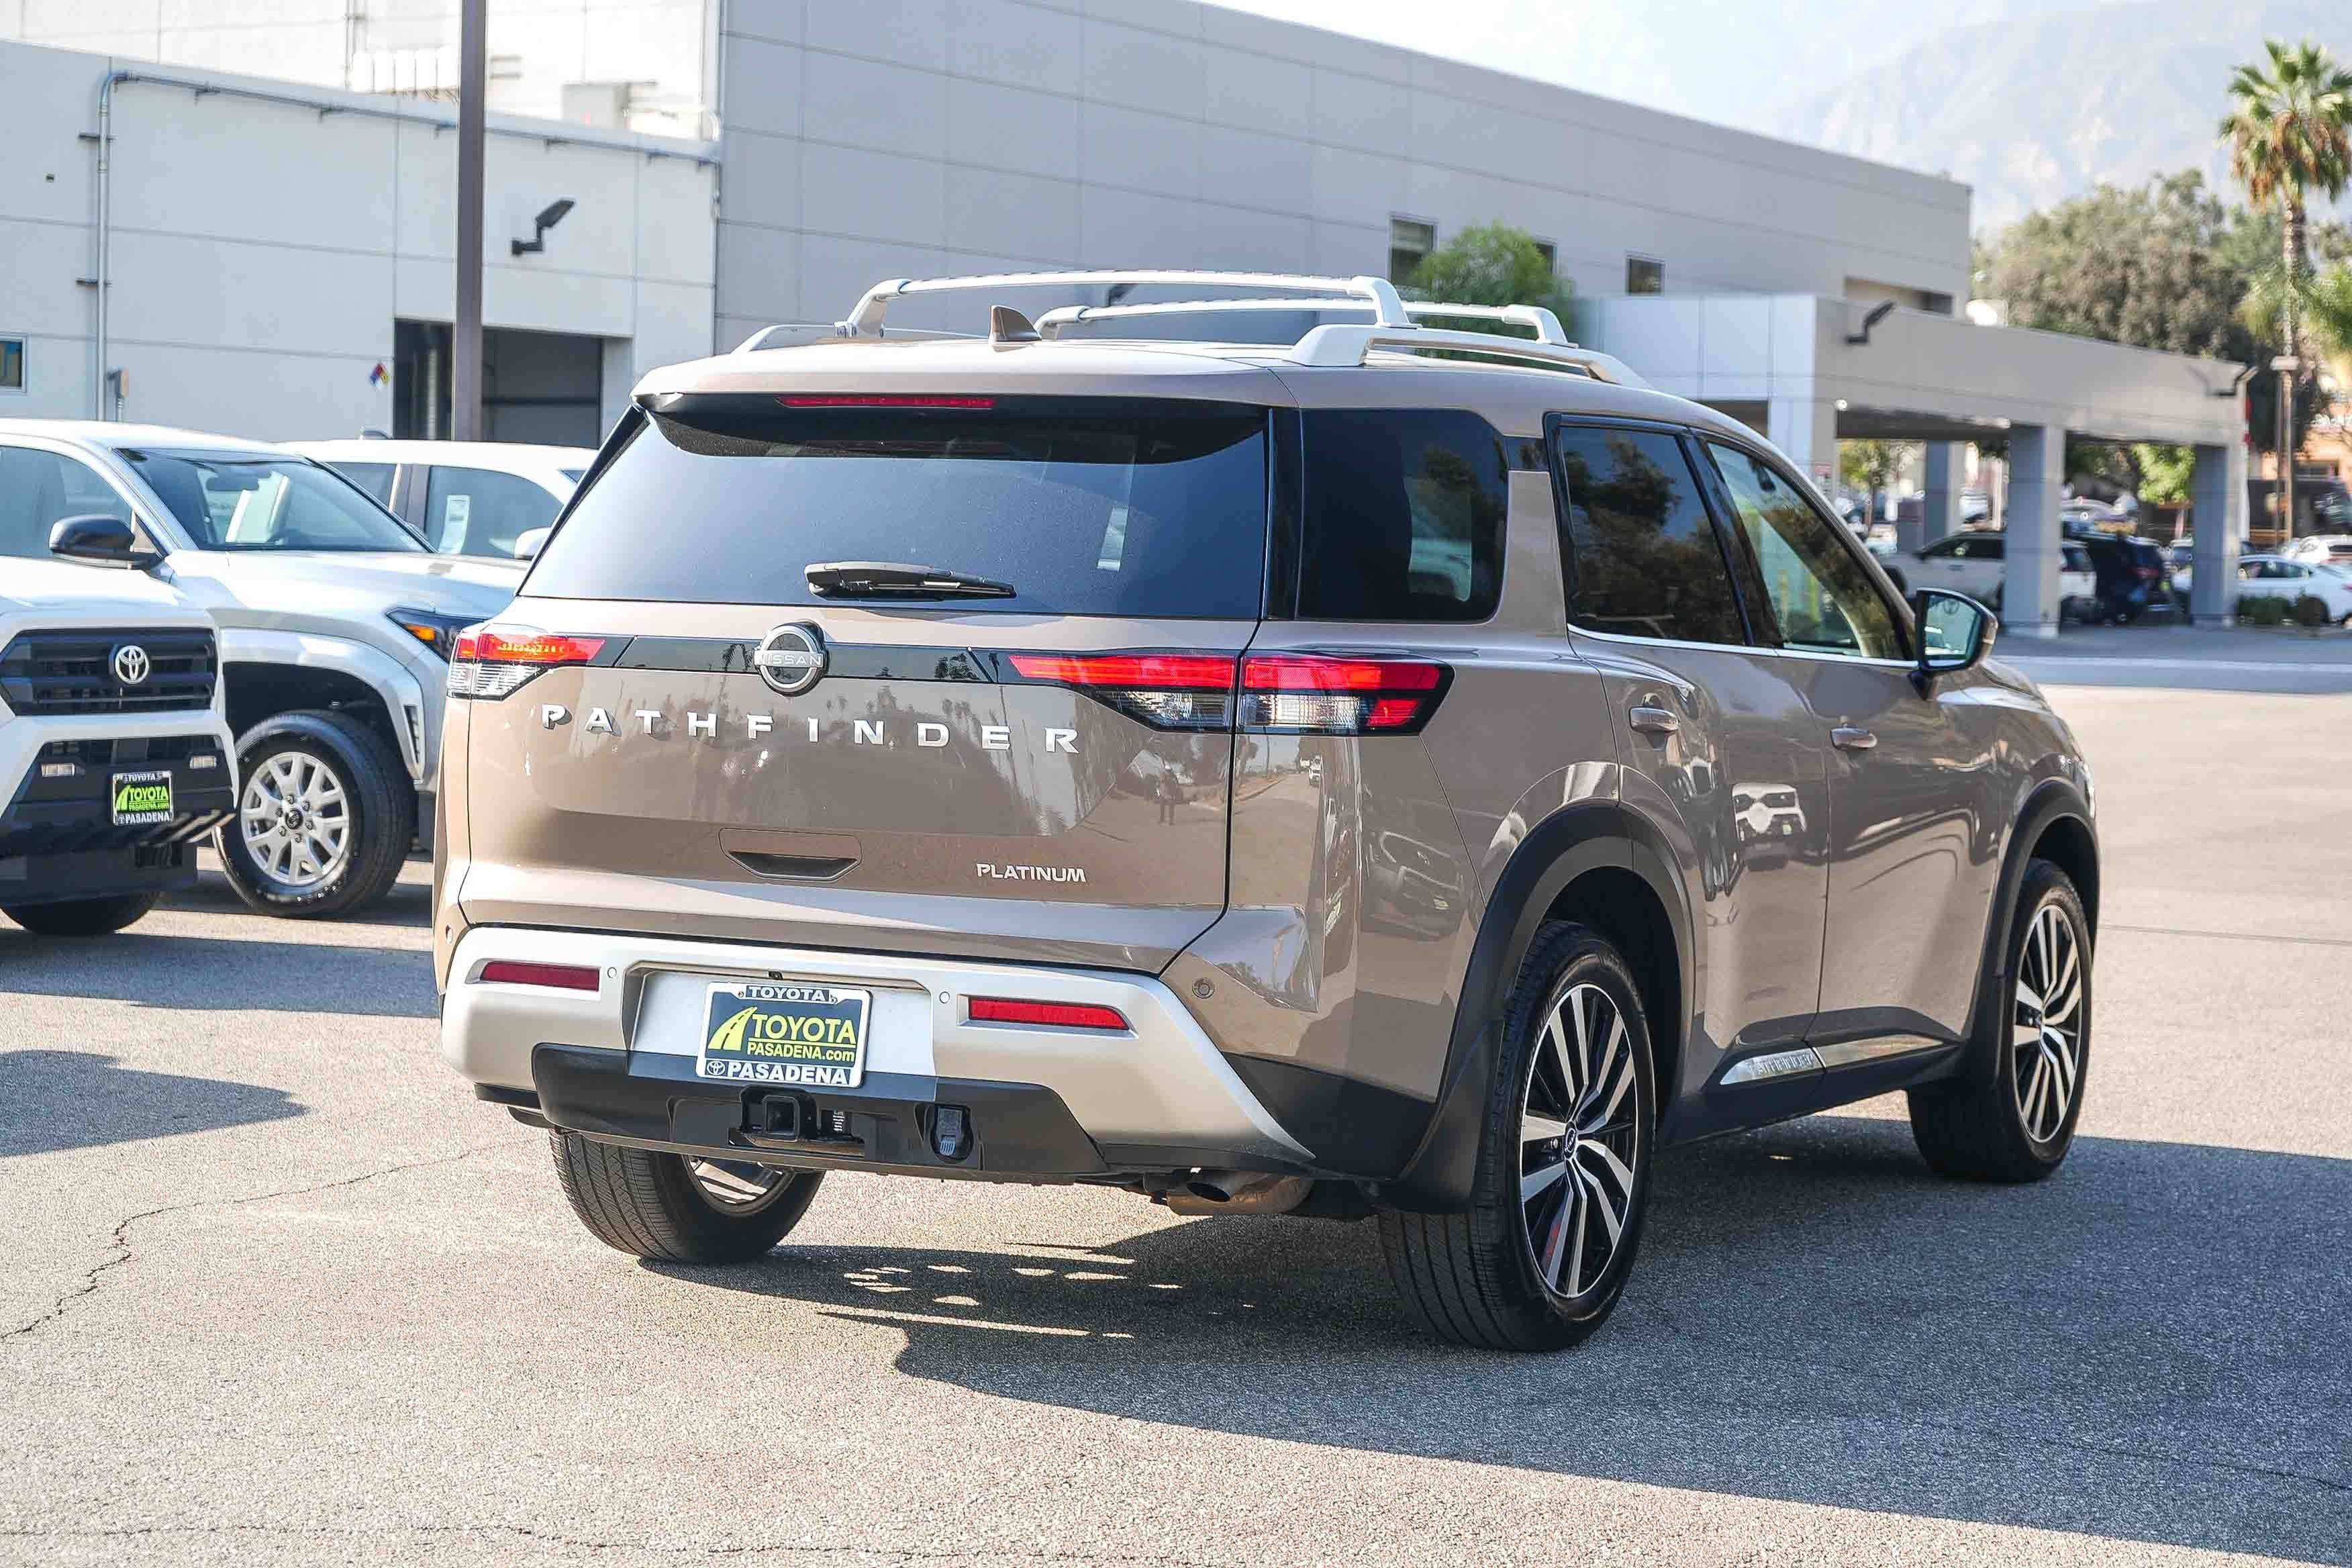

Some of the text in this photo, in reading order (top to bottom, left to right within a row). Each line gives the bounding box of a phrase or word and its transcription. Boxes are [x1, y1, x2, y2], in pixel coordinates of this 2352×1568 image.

[541, 703, 1079, 754] PATHFINDER
[128, 773, 155, 782] TOYOTA
[130, 786, 168, 801] TOYOTA
[126, 812, 170, 824] PASADENA
[977, 863, 1086, 882] PLATINUM
[748, 985, 826, 1002] TOYOTA
[752, 1014, 856, 1044] TOYOTA
[747, 1042, 854, 1062] PASADENA.com
[728, 1061, 848, 1085] PASADENA
